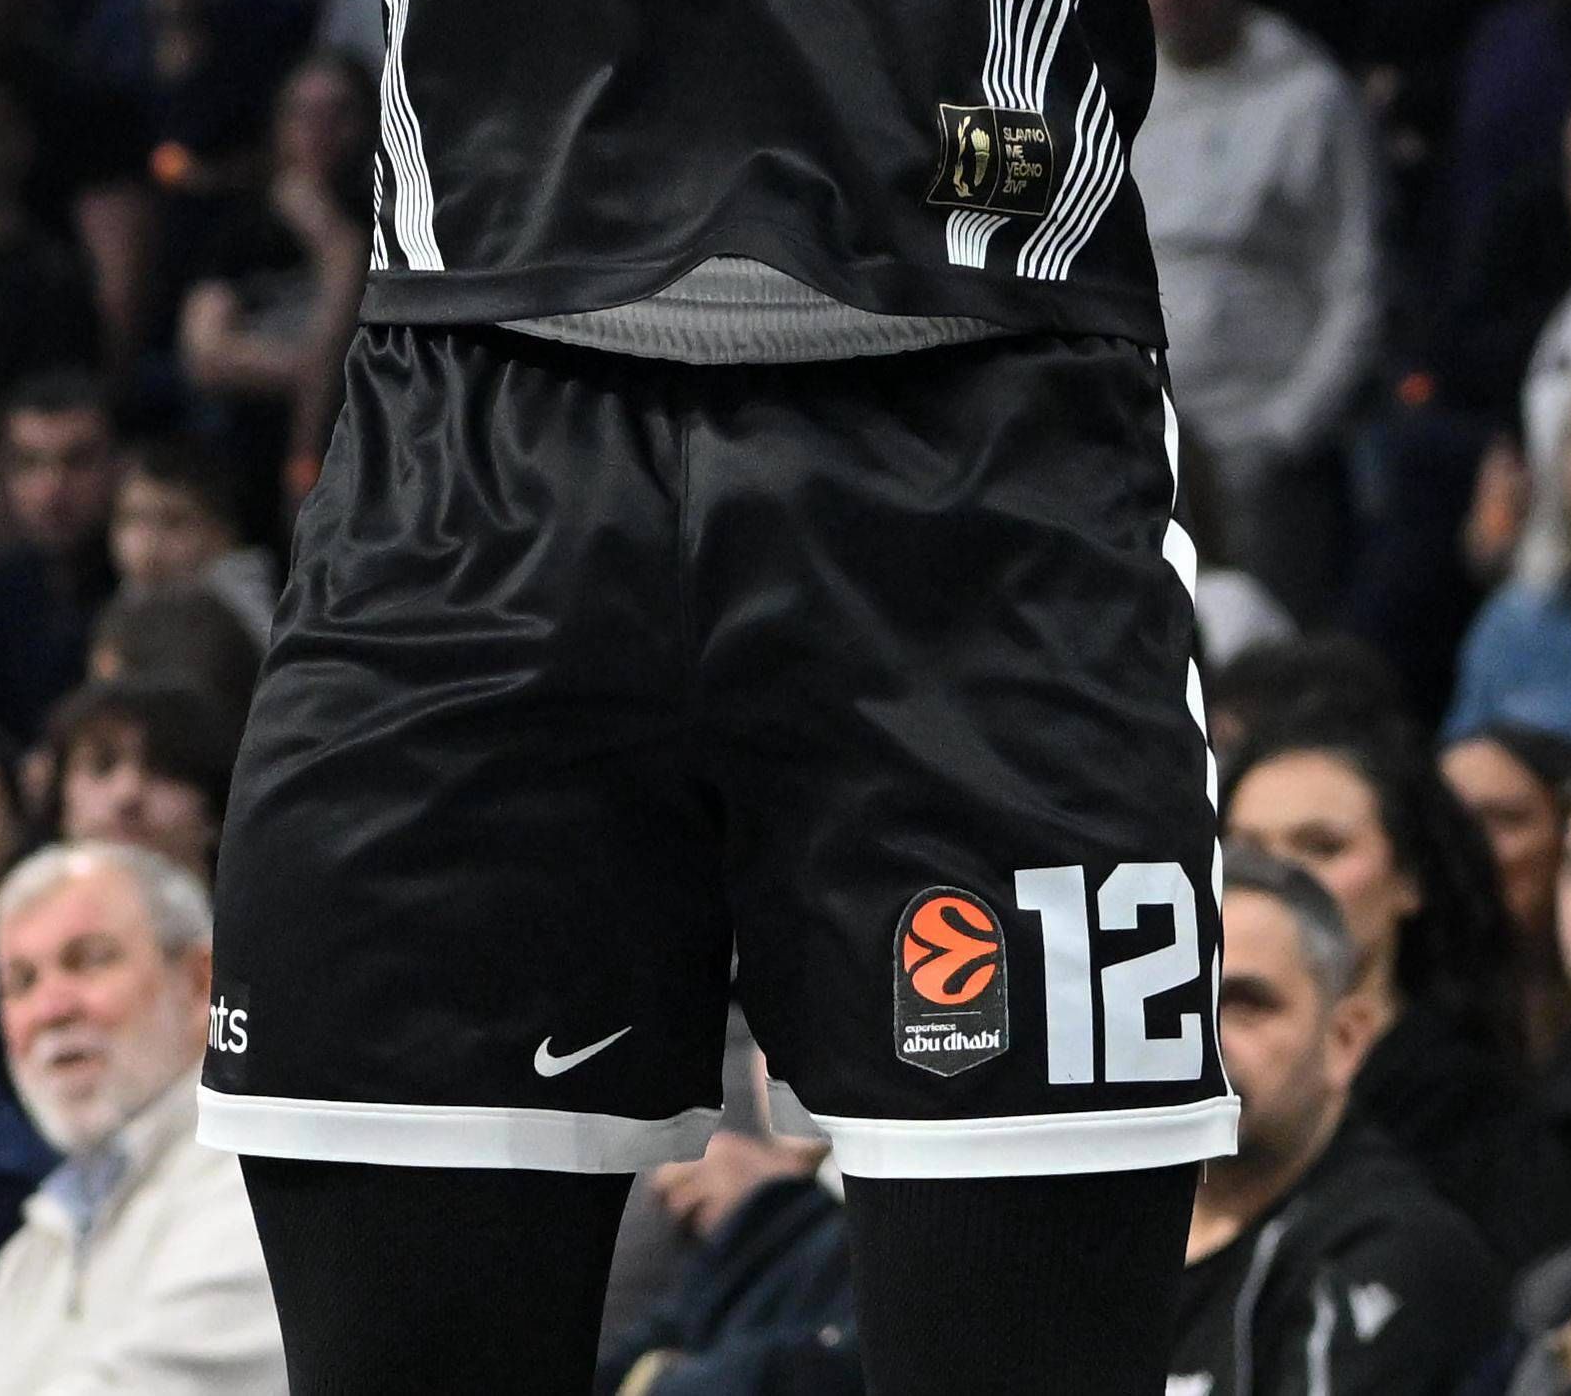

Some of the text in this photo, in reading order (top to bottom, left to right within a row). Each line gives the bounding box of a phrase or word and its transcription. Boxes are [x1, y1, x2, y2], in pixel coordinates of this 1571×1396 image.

[1014, 862, 1203, 1084] 12
[902, 1029, 1001, 1054] abu dhabi
